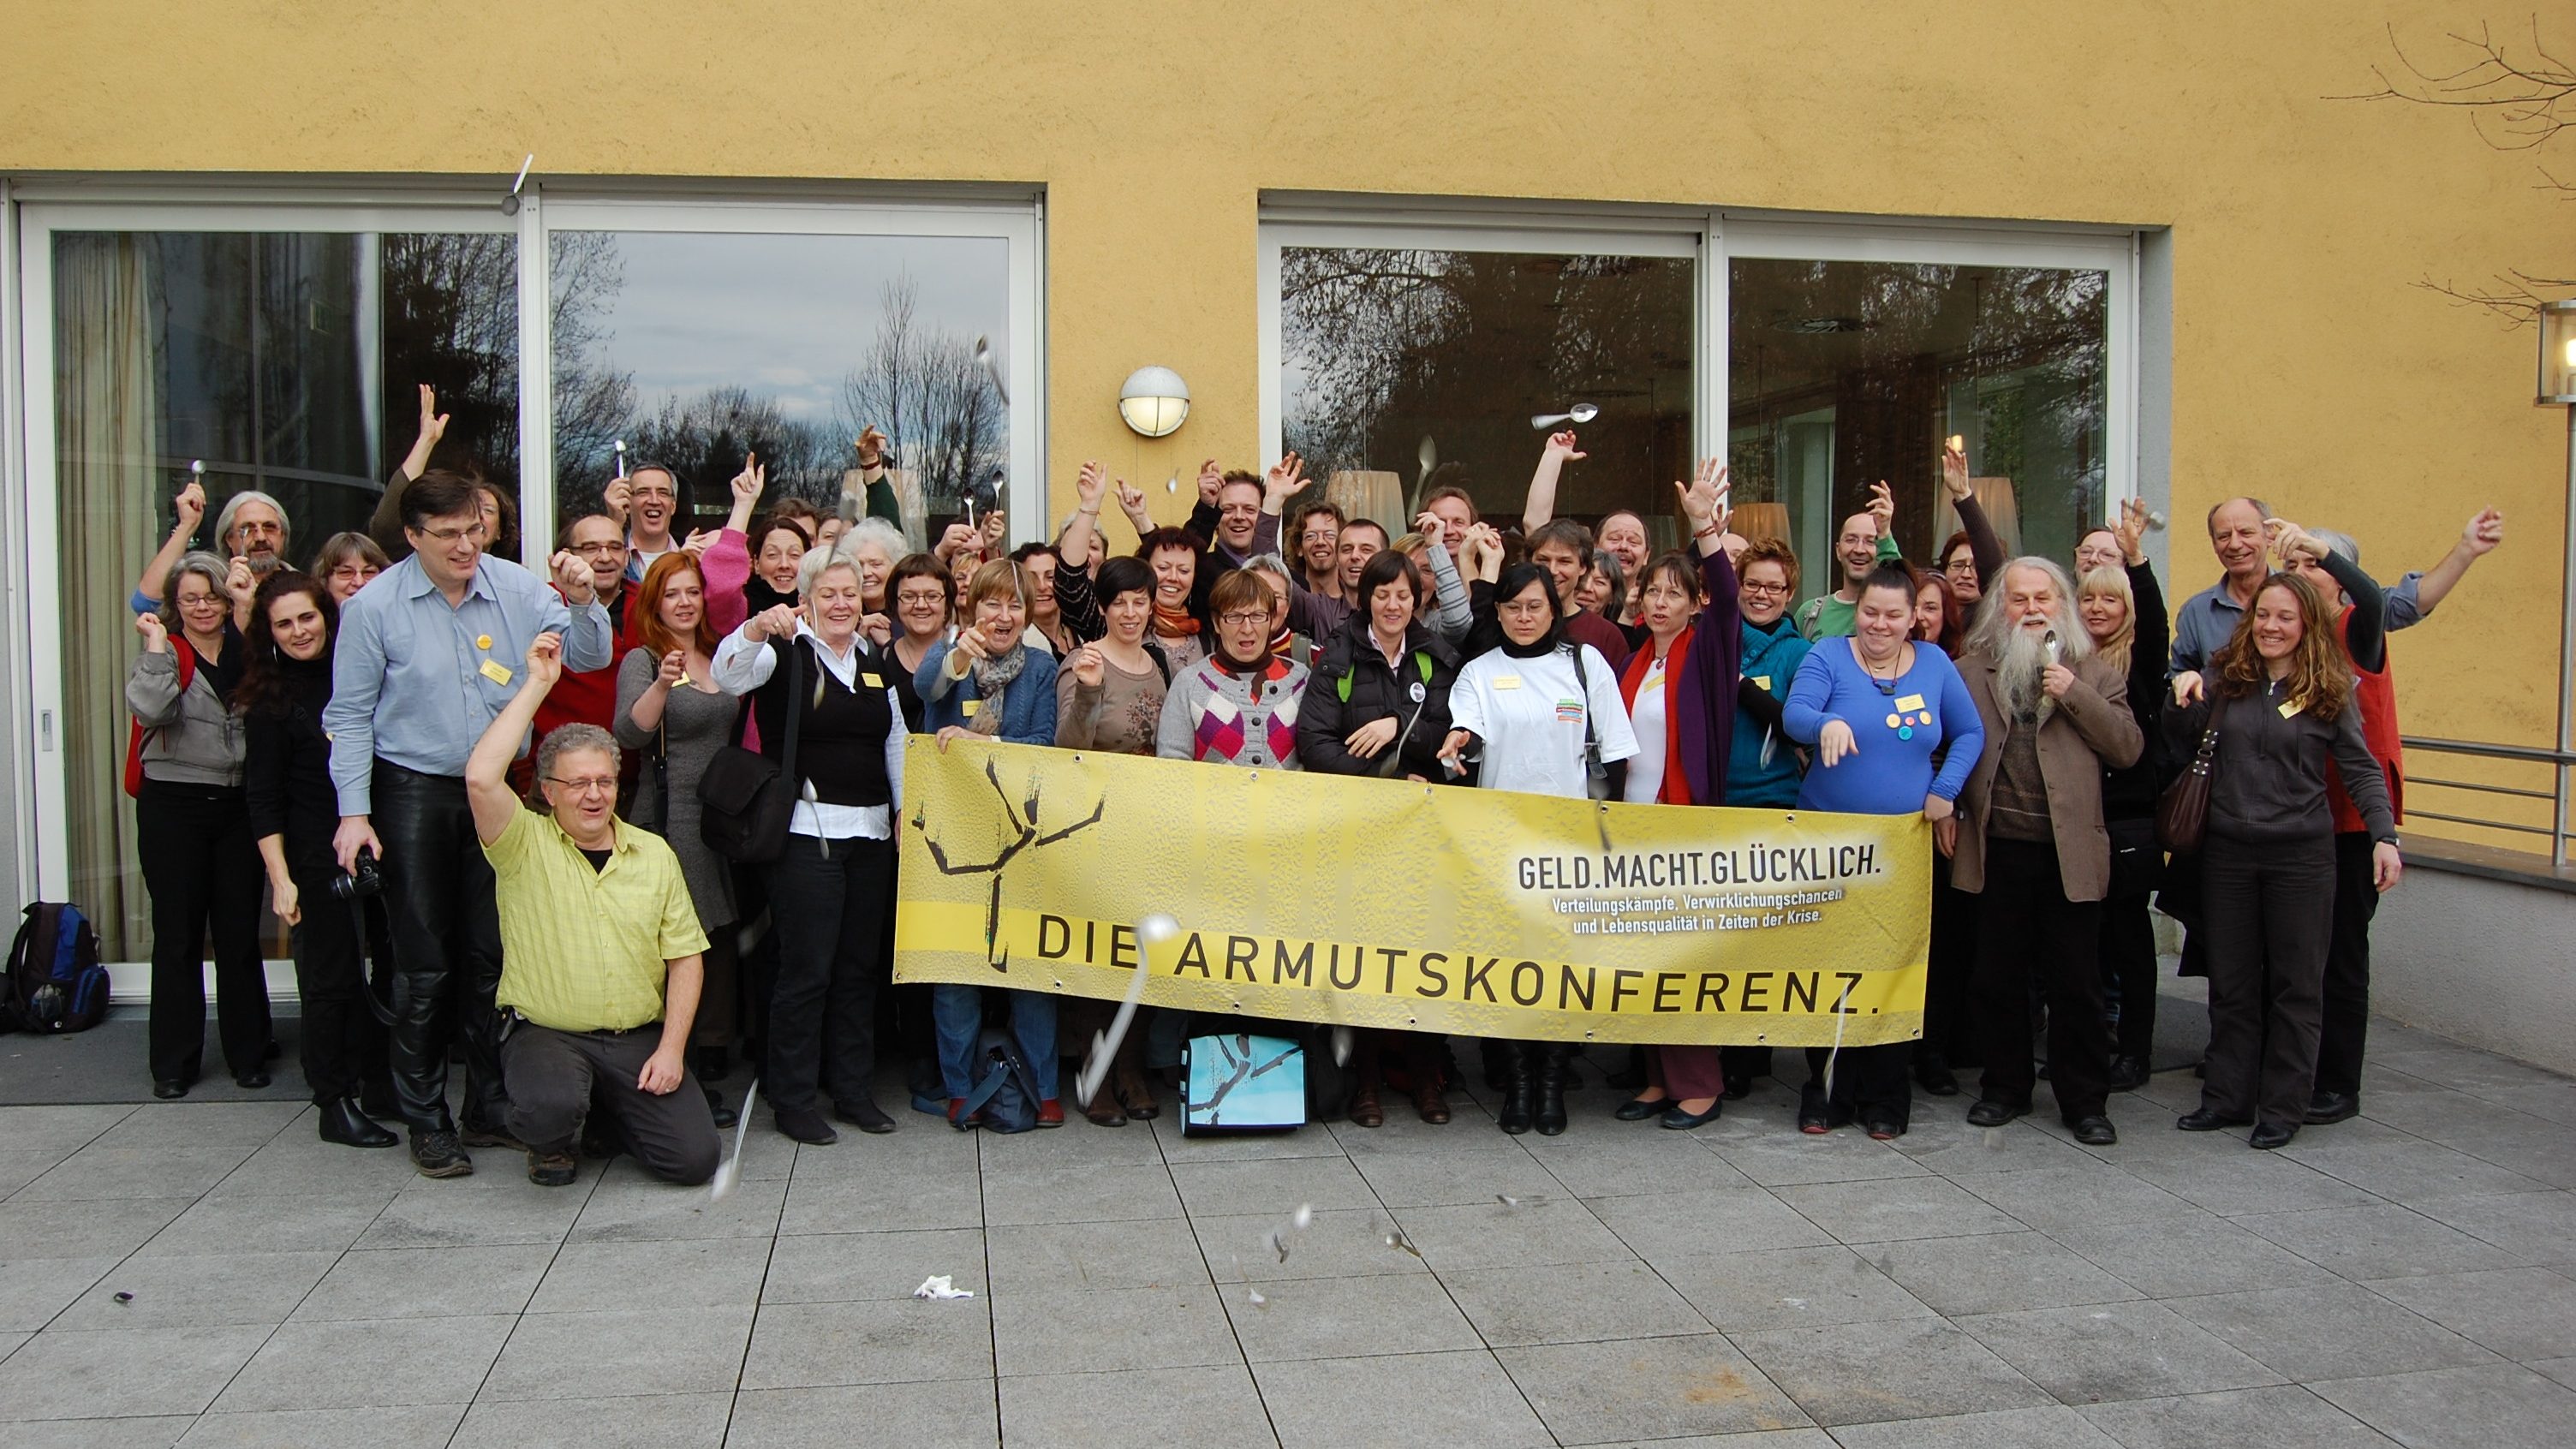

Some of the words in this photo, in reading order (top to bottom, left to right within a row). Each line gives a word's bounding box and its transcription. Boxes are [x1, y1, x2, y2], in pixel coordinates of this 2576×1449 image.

[1518, 844, 1881, 889] GELD.MACHT.GLÜCKLICH.
[1683, 888, 1842, 910] Verwirklichungschancen
[1573, 918, 1597, 933] und
[1601, 915, 1698, 935] Lebensqualität
[1702, 915, 1714, 931] in
[1718, 914, 1758, 930] Zeiten
[1762, 911, 1784, 927] der
[1786, 909, 1822, 925] Krise.
[1037, 914, 1139, 969] DIE
[1173, 932, 1879, 1014] ARMUTSKONFERENZ.
